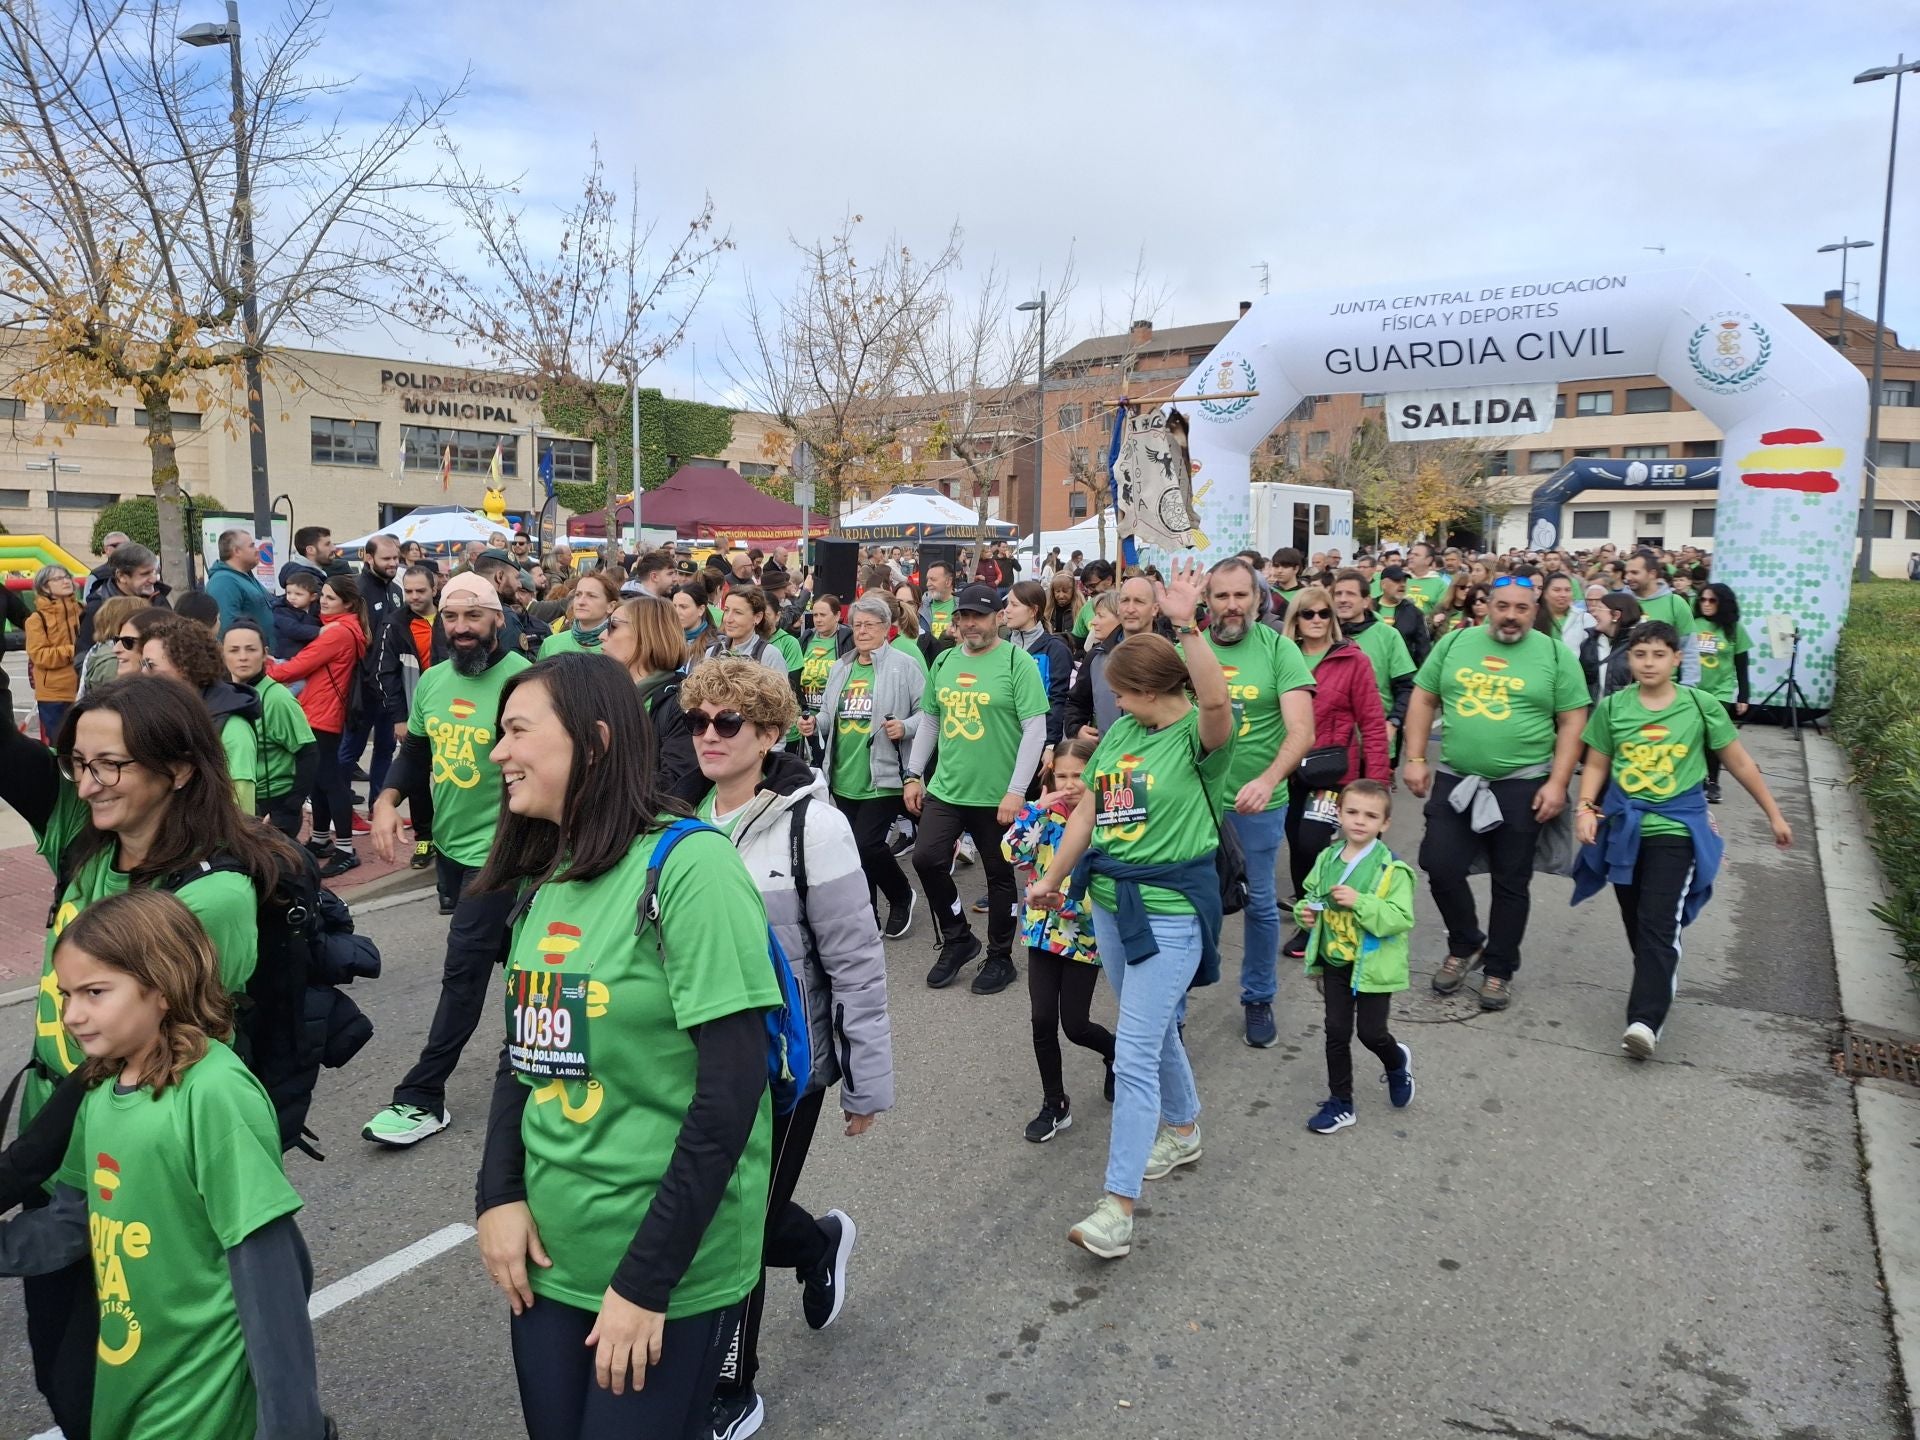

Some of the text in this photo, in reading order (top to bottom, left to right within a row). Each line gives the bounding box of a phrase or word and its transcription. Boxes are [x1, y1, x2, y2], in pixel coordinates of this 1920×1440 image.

[1330, 275, 1627, 316] JUNTA CENTRAL DE EDUCACIÓN
[1382, 302, 1559, 332] FÍSICA Y DEPORTES
[1325, 326, 1625, 375] GUARDIA CIVIL
[381, 369, 539, 402] POLIDEPORTIVO
[404, 397, 518, 424] MUNICIPAL
[1401, 397, 1538, 429] SALIDA
[873, 526, 902, 539] CIVIL
[1456, 667, 1525, 690] Corre
[844, 698, 872, 711] 1270
[939, 687, 990, 705] Corre
[1463, 682, 1509, 702] TEA
[944, 702, 981, 719] TEA
[426, 716, 491, 745] Corre
[433, 735, 476, 762] TEA
[1620, 742, 1689, 759] Corre
[1103, 787, 1135, 812] 240
[514, 1004, 571, 1048] 1039
[532, 1063, 552, 1074] CIVIL
[565, 1068, 585, 1076] RIOJA
[533, 1049, 585, 1064] SOLIDARIA
[90, 1211, 151, 1258] orre
